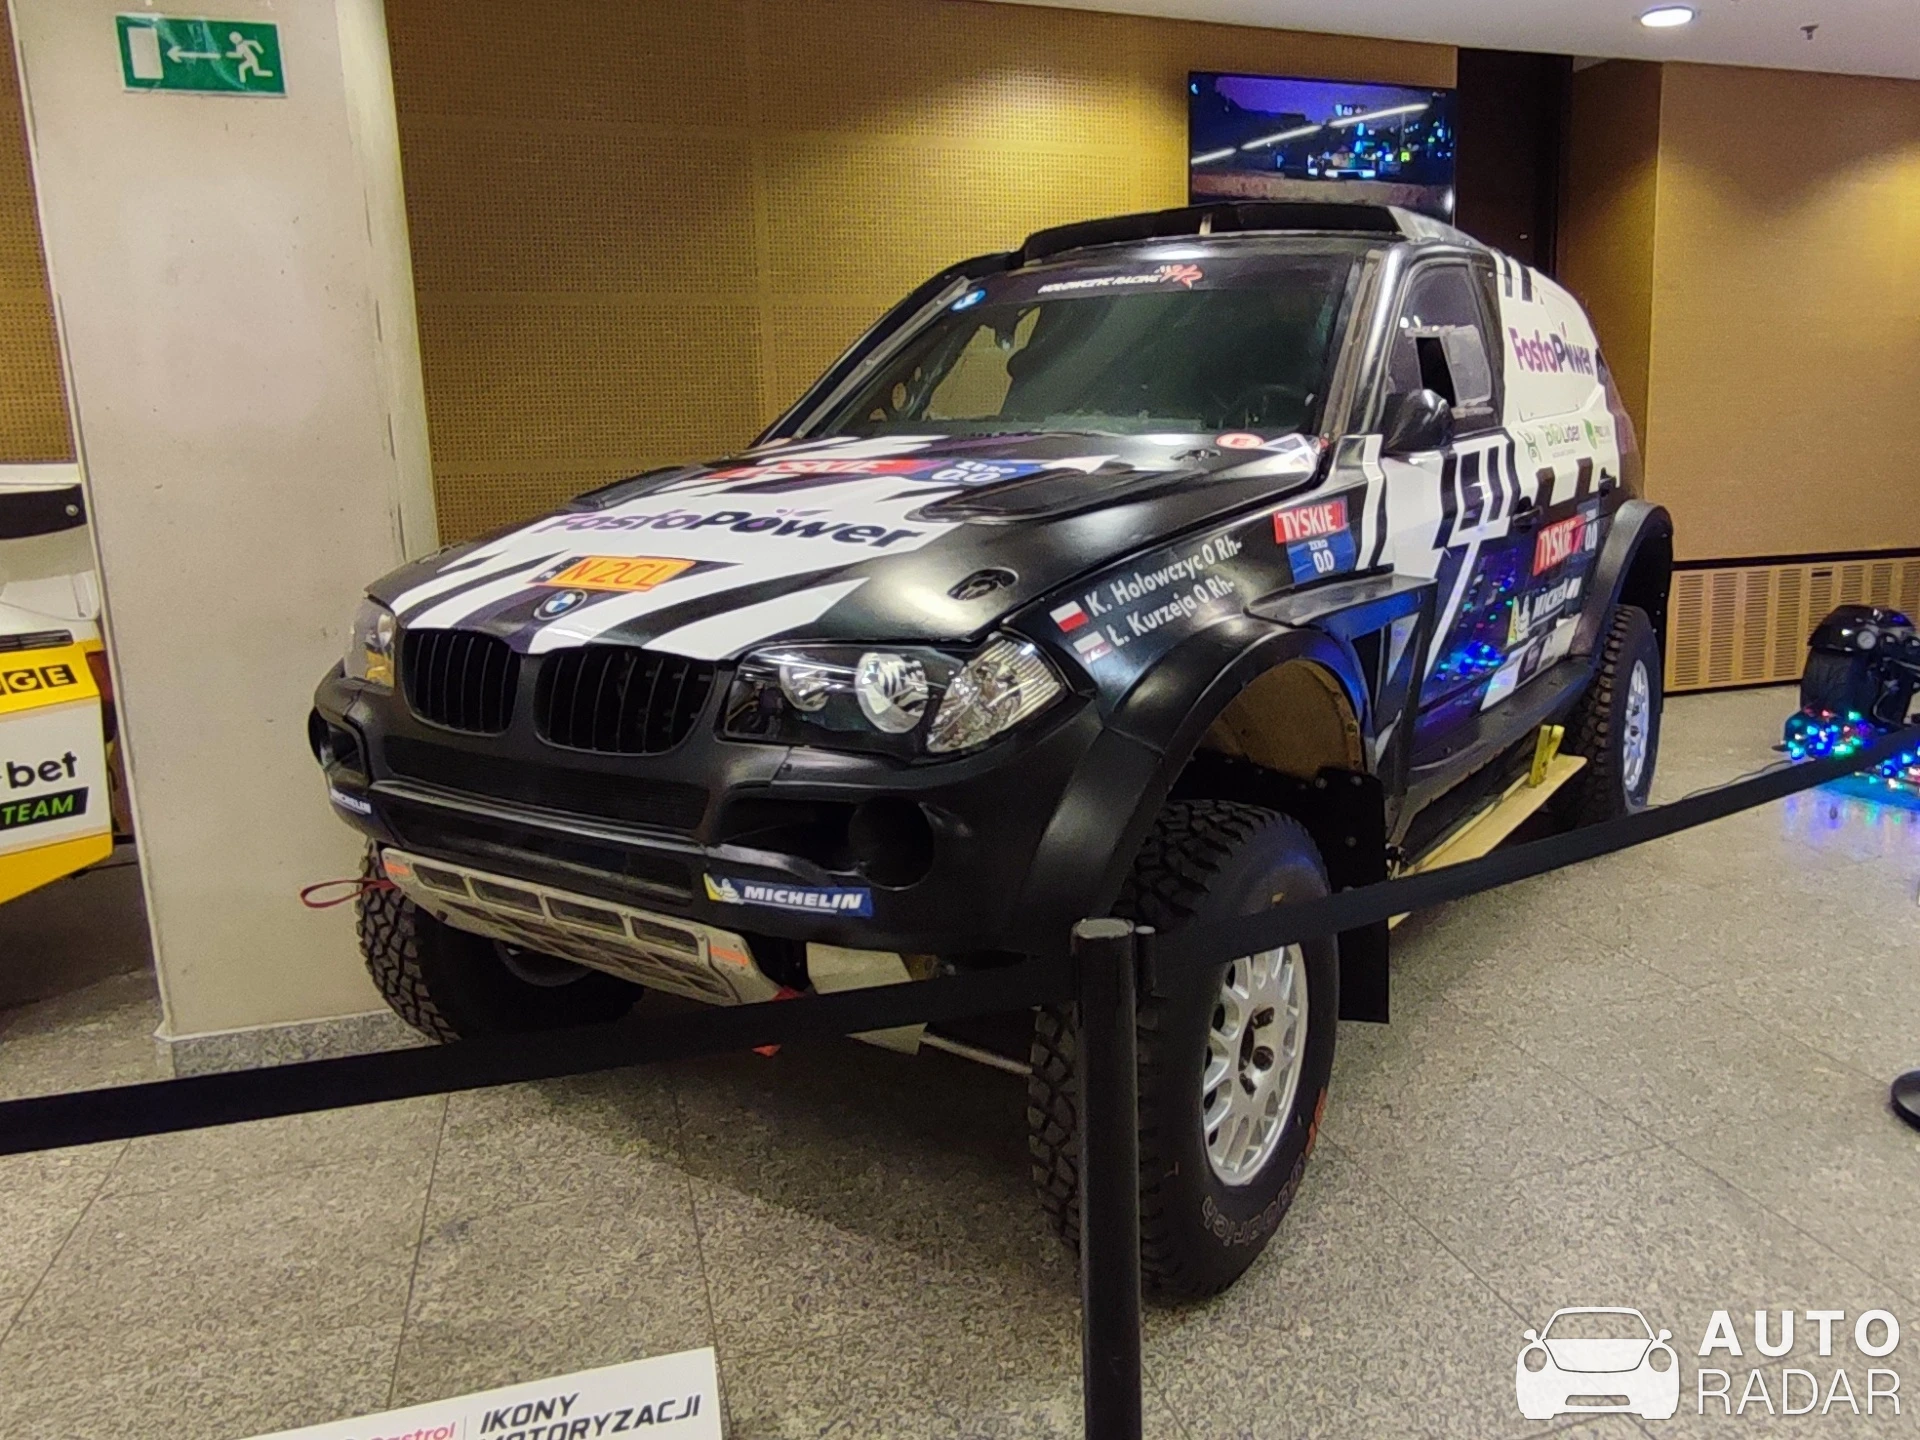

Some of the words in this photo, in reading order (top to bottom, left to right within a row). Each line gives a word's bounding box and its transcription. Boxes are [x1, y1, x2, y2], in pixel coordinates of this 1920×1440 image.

[1277, 504, 1337, 541] TYSKIE
[1084, 591, 1113, 618] K.
[1110, 554, 1204, 606] Hołowczyc
[1214, 534, 1243, 561] Rh-
[1126, 592, 1198, 637] Kurzeja
[1205, 574, 1235, 599] Rh-
[0, 667, 70, 691] GE
[0, 751, 78, 789] bet
[1, 794, 75, 825] TEAM
[743, 885, 863, 910] MICHELIN
[480, 1392, 580, 1434] IKONY
